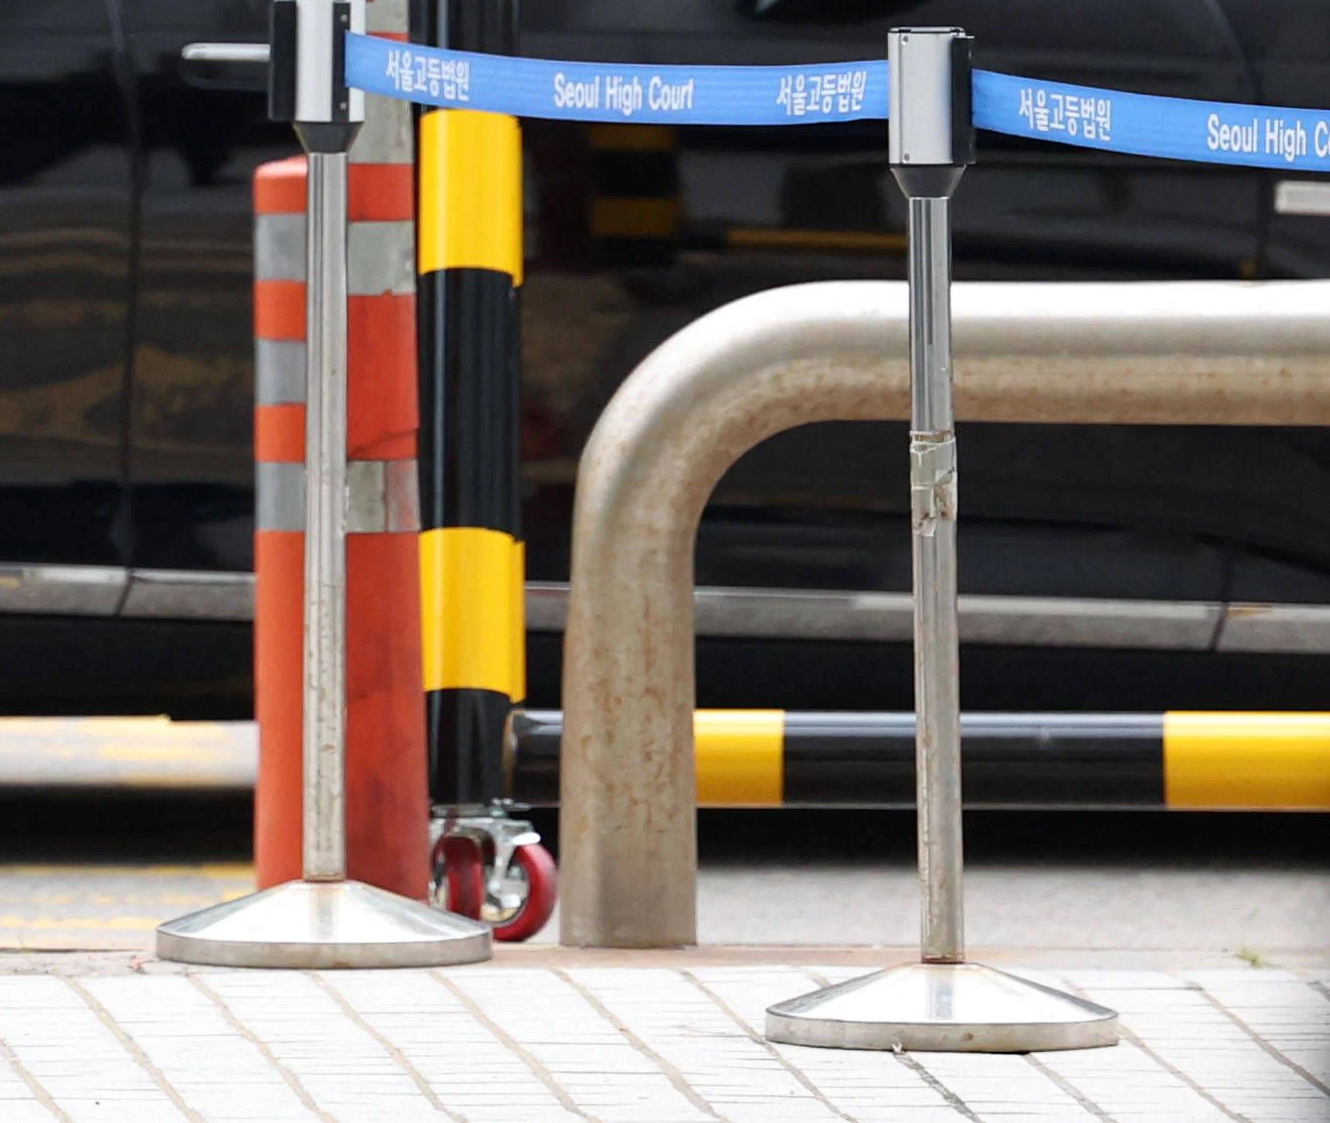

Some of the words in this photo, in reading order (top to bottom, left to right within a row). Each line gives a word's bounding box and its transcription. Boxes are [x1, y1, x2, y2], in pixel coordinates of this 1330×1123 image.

[385, 49, 470, 102] 서울고등법원
[553, 71, 600, 109] Seoul
[605, 75, 643, 116] High
[649, 75, 695, 111] Court
[776, 70, 867, 116] 서울고등법원
[1018, 87, 1112, 141] 서울고등법원
[1207, 113, 1258, 153] Seoul
[1265, 118, 1307, 163] High
